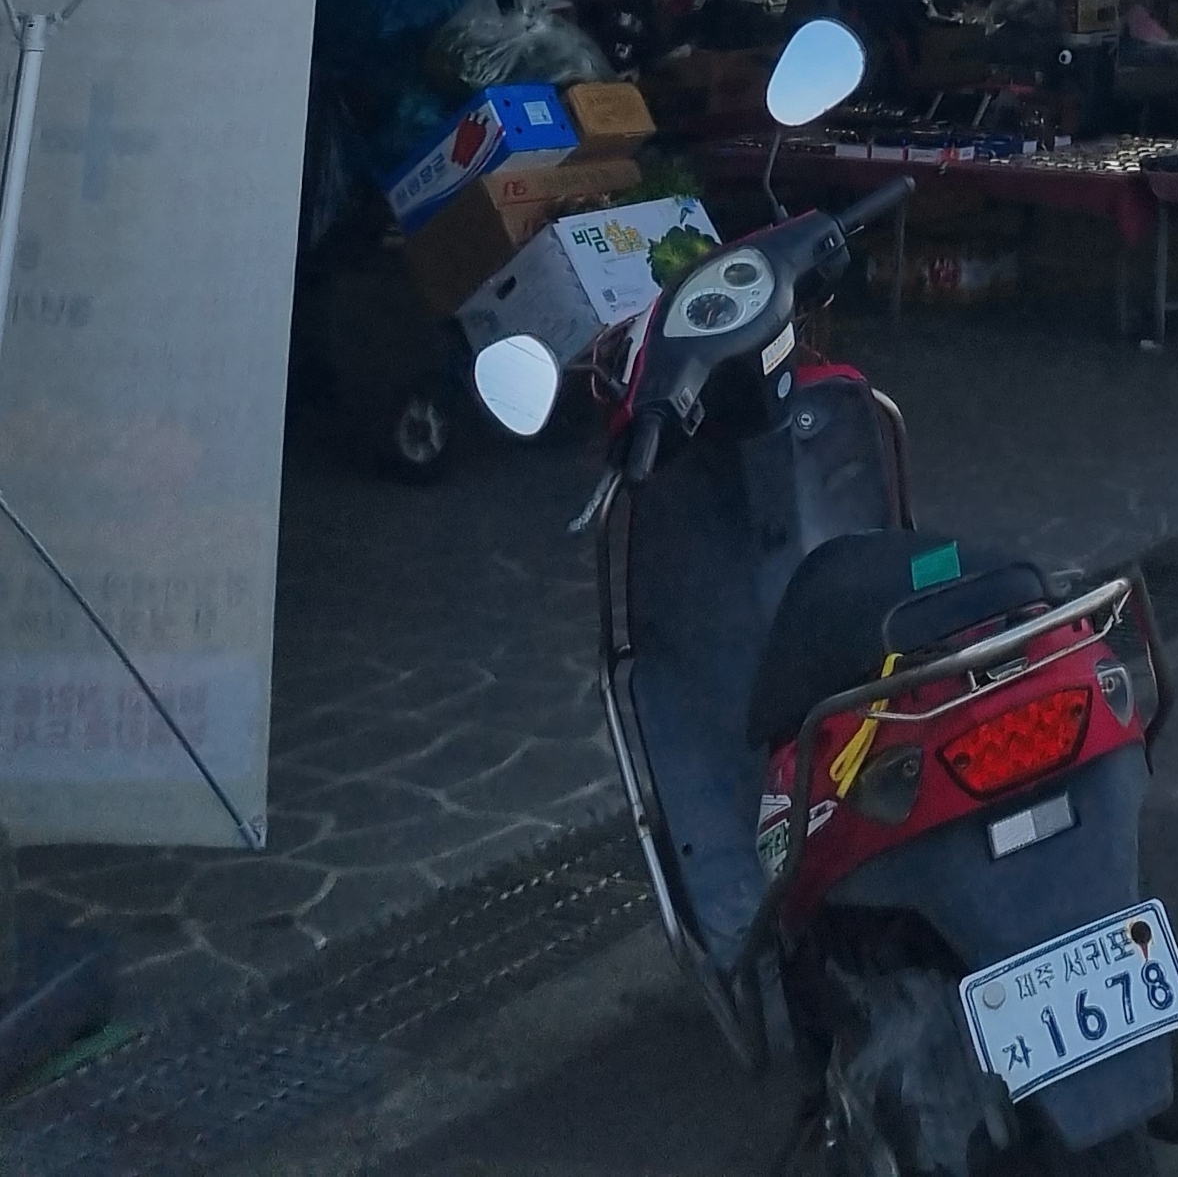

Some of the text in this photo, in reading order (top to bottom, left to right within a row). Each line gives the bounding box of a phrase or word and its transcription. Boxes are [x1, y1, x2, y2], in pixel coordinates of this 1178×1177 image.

[572, 226, 611, 254] 비금
[1015, 927, 1136, 1001] 제주 서귀포
[1002, 961, 1174, 1073] 자 1678
